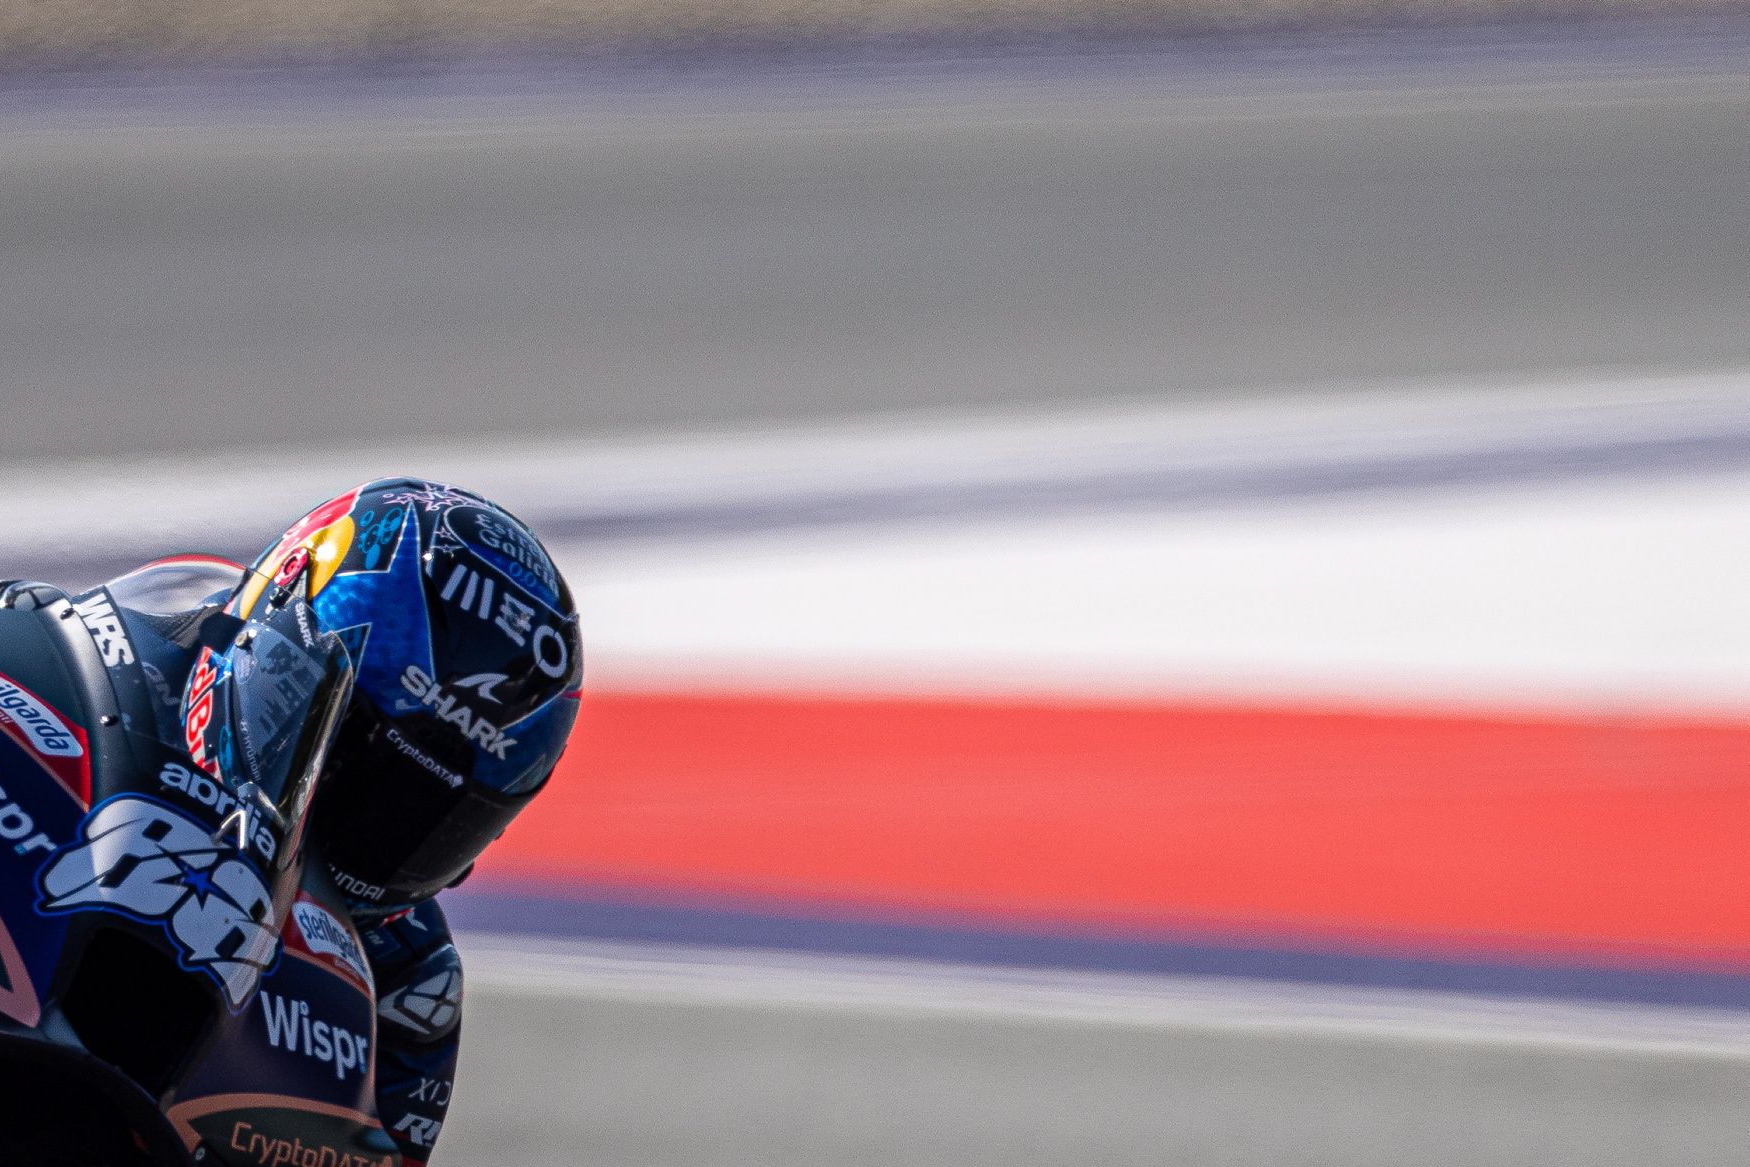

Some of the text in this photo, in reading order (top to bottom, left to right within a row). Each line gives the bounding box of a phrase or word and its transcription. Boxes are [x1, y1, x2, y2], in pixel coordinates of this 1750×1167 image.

[72, 592, 135, 667] WRS
[295, 600, 314, 648] SHARK
[400, 665, 518, 760] SHARK
[386, 728, 457, 786] CryptoDATA
[261, 991, 368, 1079] Wispr
